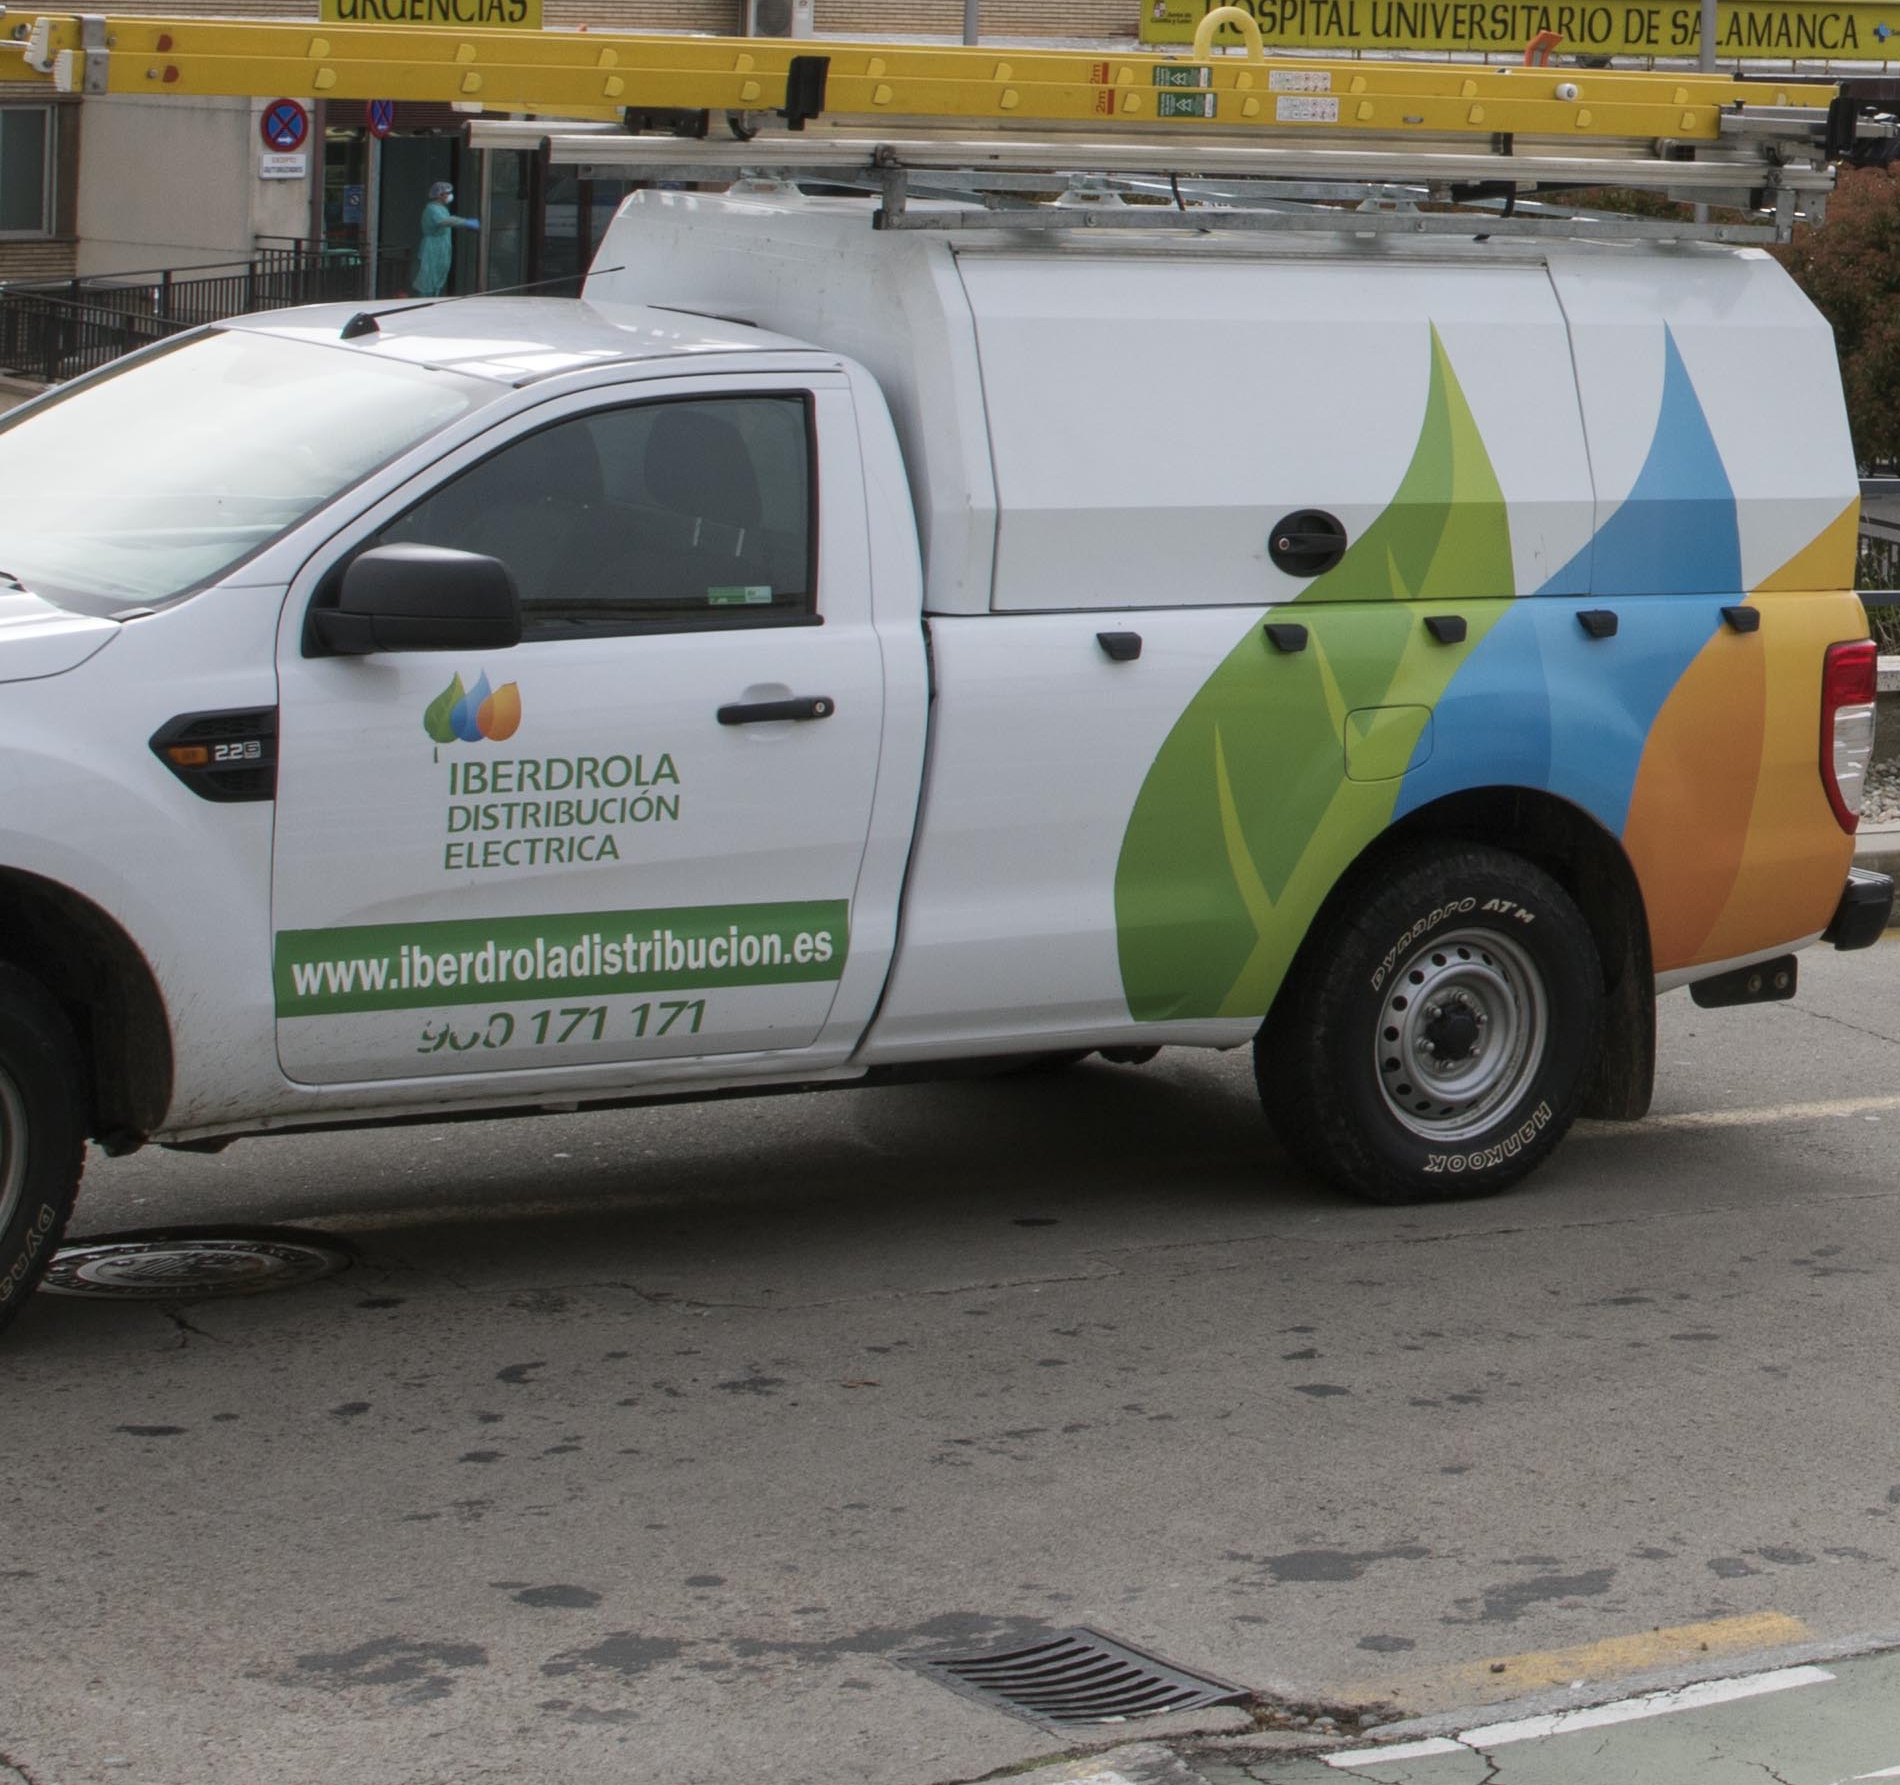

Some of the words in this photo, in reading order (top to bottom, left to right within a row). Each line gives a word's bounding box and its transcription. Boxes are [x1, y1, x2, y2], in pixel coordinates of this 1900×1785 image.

[1371, 0, 1613, 44] UNIVERSITARIO
[1623, 8, 1661, 45] DE
[1671, 9, 1860, 50] SAAMANCA
[450, 753, 681, 796] IBERDROLA
[447, 789, 680, 833] DISTRIBUCIÓN
[444, 834, 620, 870] ELECTRICA
[291, 924, 834, 997] www.iberdroladistribucion.es
[529, 1005, 610, 1046] 171
[630, 998, 707, 1038] 171
